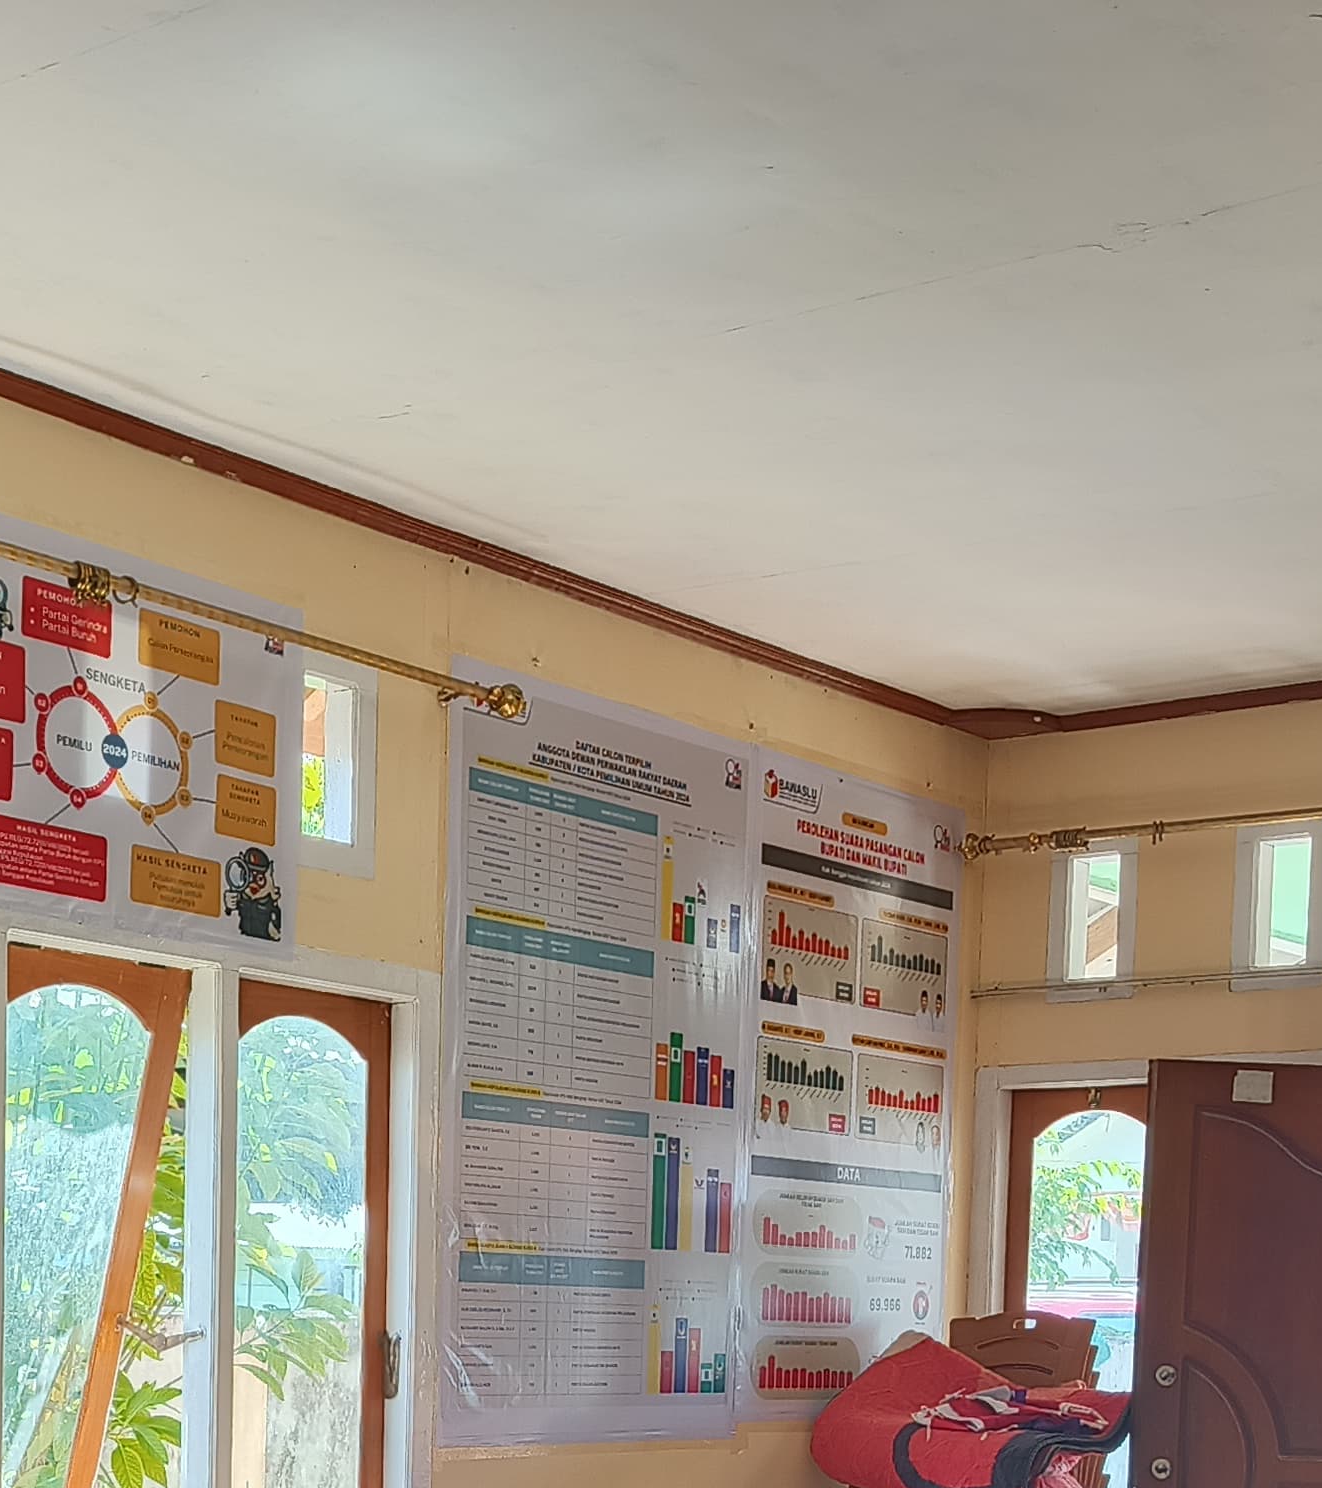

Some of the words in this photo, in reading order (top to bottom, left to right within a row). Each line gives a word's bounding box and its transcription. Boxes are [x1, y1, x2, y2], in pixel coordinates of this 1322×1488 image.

[42, 607, 70, 623] Partai
[71, 614, 109, 634] Gerindra
[42, 619, 70, 636] Partai
[71, 628, 97, 643] Buruh
[159, 618, 201, 638] PEMOHON
[86, 667, 146, 694] SENGKETA
[56, 734, 93, 752] PEMILU
[102, 743, 127, 758] 2024
[131, 750, 180, 771] PEMILIHAN
[532, 753, 571, 772] KABUPATEN
[537, 742, 570, 759] ANGGOTA
[571, 750, 595, 766] DEWAN
[596, 756, 637, 776] PERWAKILAN
[638, 768, 661, 784] RAKYAT
[576, 740, 600, 755] DAFTAR
[601, 746, 623, 762] CALON
[625, 753, 652, 770] TERPILIH
[779, 778, 818, 799] BAWASLU
[796, 819, 839, 843] PEROLEHAN
[840, 831, 864, 849] SUARA
[865, 839, 903, 859] PASANGAN
[903, 850, 925, 865] CALON
[136, 853, 162, 866] HASIL
[164, 859, 208, 875] SENGKETA
[820, 842, 845, 859] BUPATI
[846, 850, 861, 864] DAN
[862, 855, 882, 871] WAKIL
[884, 861, 908, 876] BUPATI
[836, 1167, 862, 1182] DATA
[904, 1245, 933, 1261] 71.882
[869, 1298, 901, 1312] 69.966
